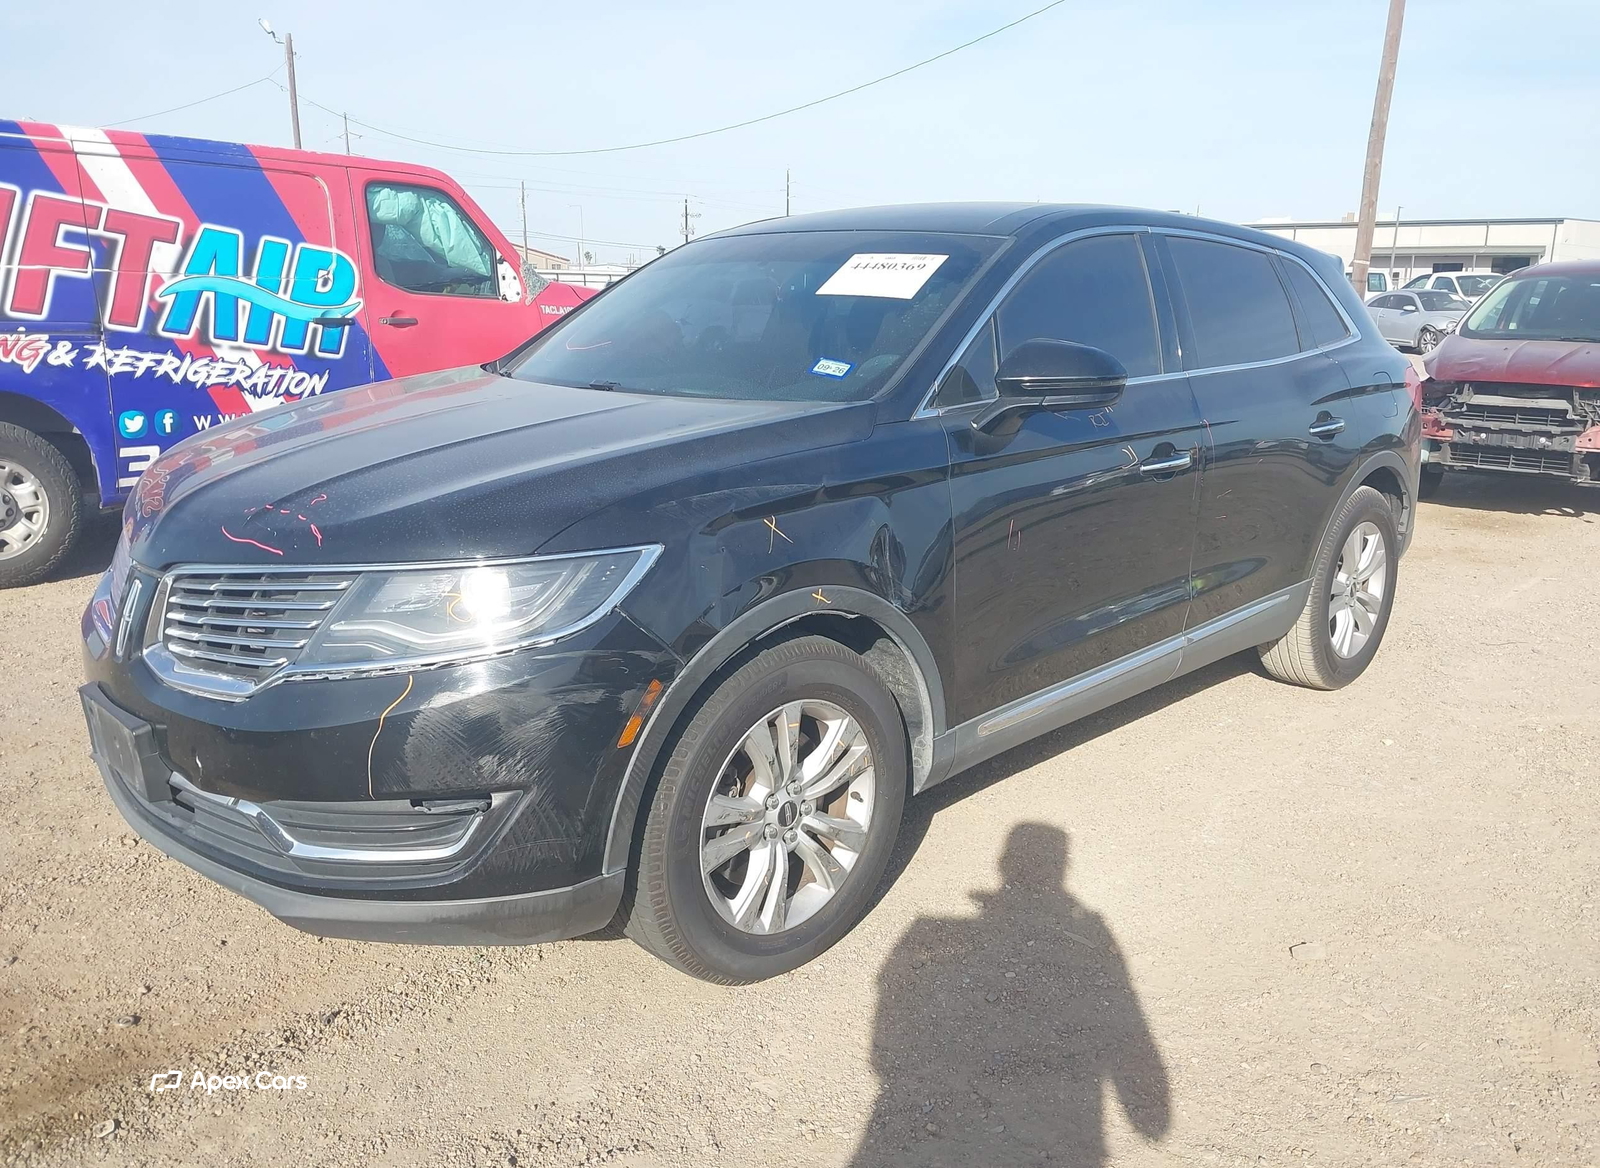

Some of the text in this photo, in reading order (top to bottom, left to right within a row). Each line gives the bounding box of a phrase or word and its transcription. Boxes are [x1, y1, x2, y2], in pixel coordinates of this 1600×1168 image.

[160, 226, 361, 356] AIR
[47, 340, 79, 368] &
[82, 341, 330, 399] REFRIGERATION
